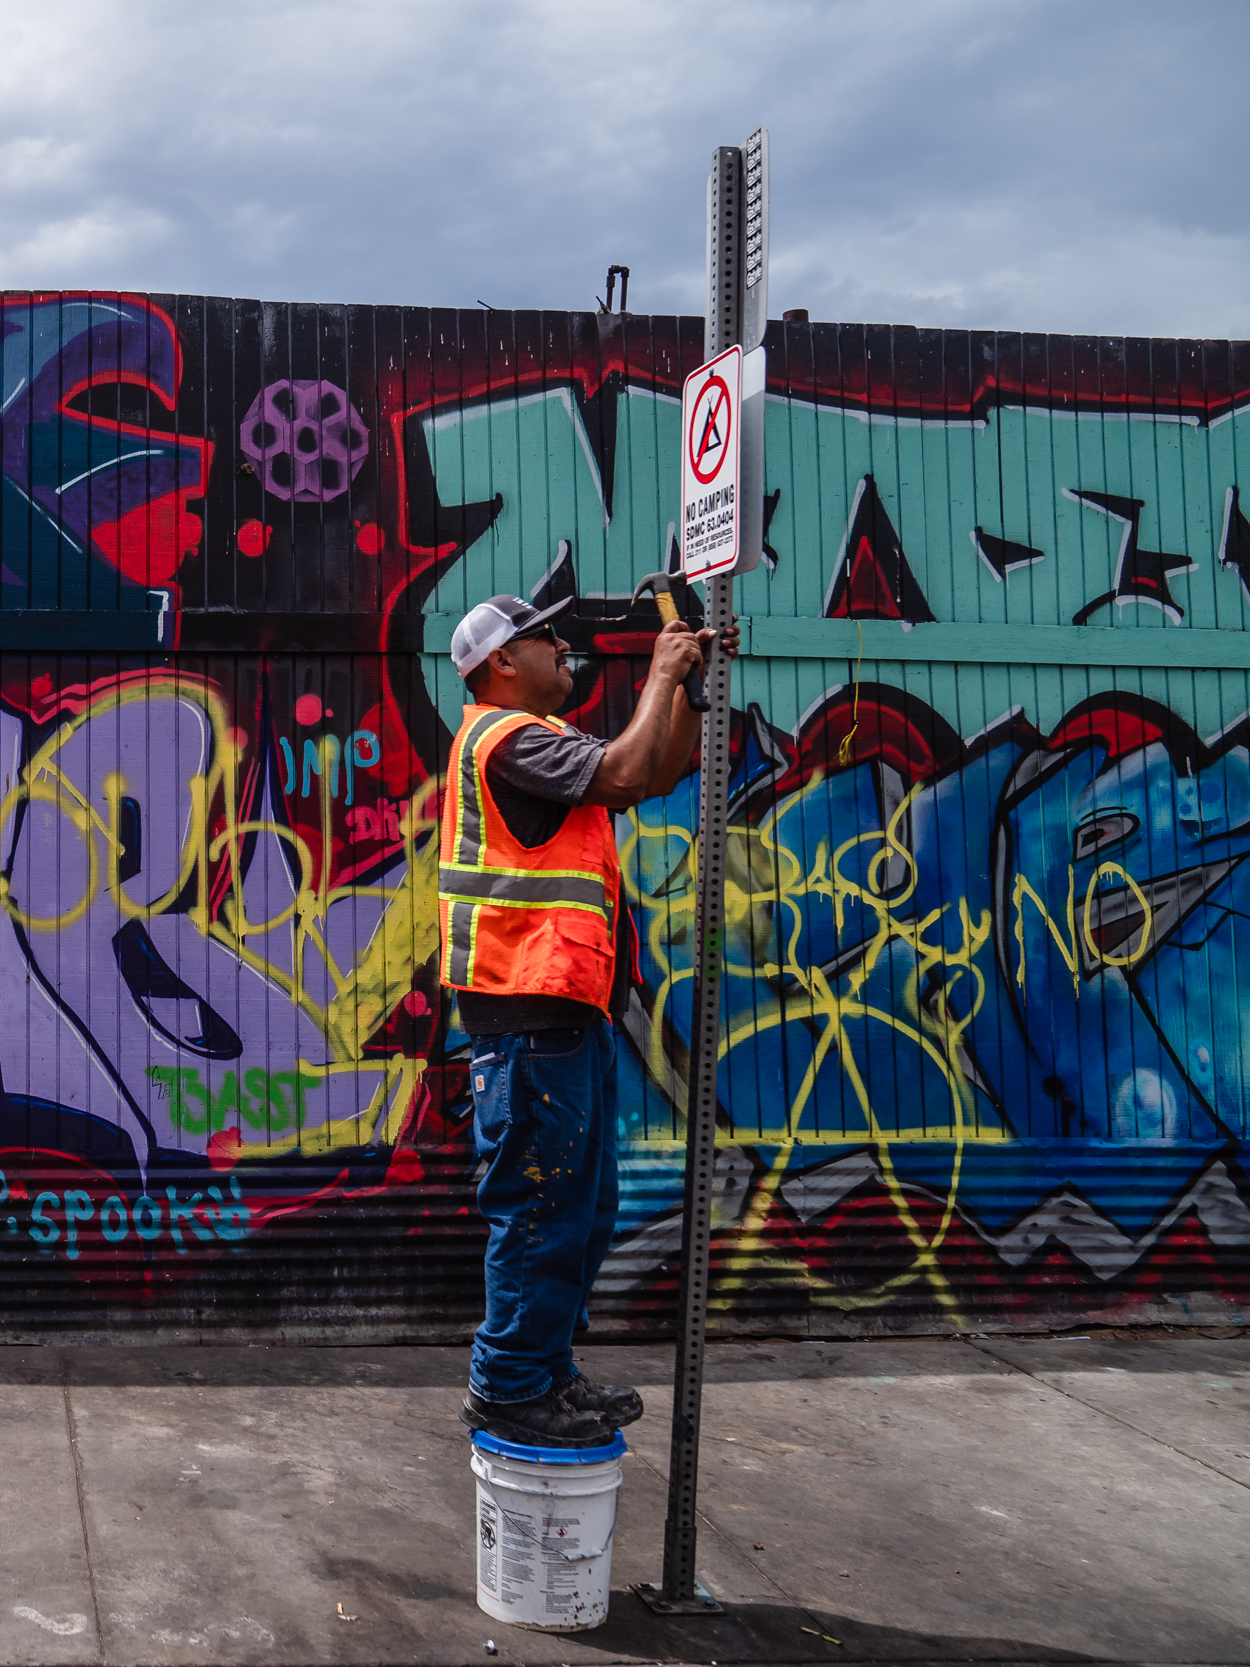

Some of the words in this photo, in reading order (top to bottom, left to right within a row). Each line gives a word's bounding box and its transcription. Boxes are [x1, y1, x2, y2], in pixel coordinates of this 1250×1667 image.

[686, 502, 696, 523] NO
[698, 484, 734, 518] CAMPING
[686, 521, 705, 541] SDMC
[707, 508, 734, 532] 63.0404
[279, 730, 380, 806] IMP
[1013, 861, 1152, 992] NO
